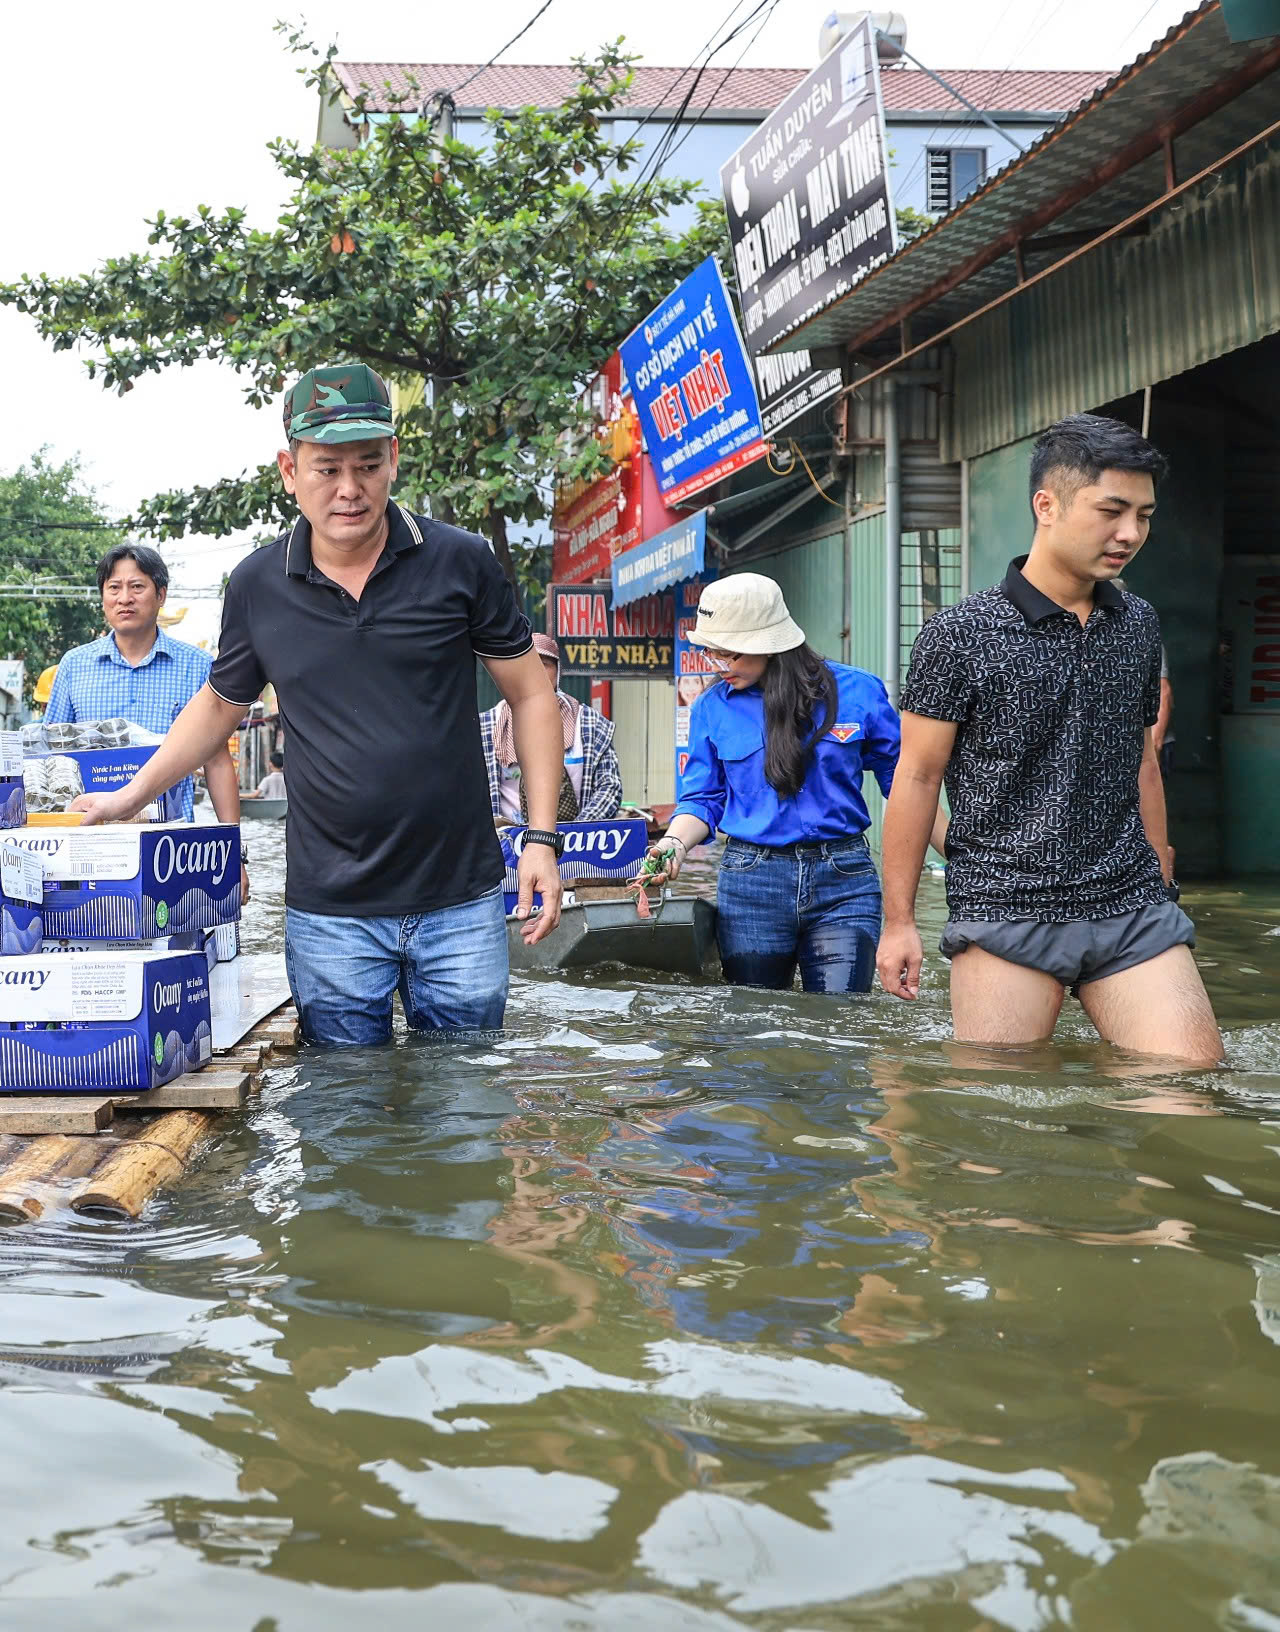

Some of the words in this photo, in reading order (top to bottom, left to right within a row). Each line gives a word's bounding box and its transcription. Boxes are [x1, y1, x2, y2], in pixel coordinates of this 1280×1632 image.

[749, 124, 781, 180] TUẤN
[783, 79, 834, 148] DUYÊN
[735, 222, 766, 294] ĐIỆN
[761, 188, 800, 268] THOẠI
[806, 147, 842, 228] MÁY
[840, 116, 883, 197] TÍNH
[635, 361, 651, 391] CƠ
[648, 349, 662, 380] SỞ
[658, 332, 685, 372] DỊCH
[681, 322, 699, 351] VỤ
[694, 315, 705, 339] Y
[702, 293, 718, 332] TẾ
[649, 382, 688, 442] VIỆT
[680, 349, 732, 421] NHẬT
[557, 594, 609, 638] NHA
[613, 594, 675, 638] KHOA
[564, 639, 613, 669] VIỆT
[616, 639, 672, 669] NHẬT
[153, 834, 233, 886] Ocany
[153, 981, 182, 1014] Ocany
